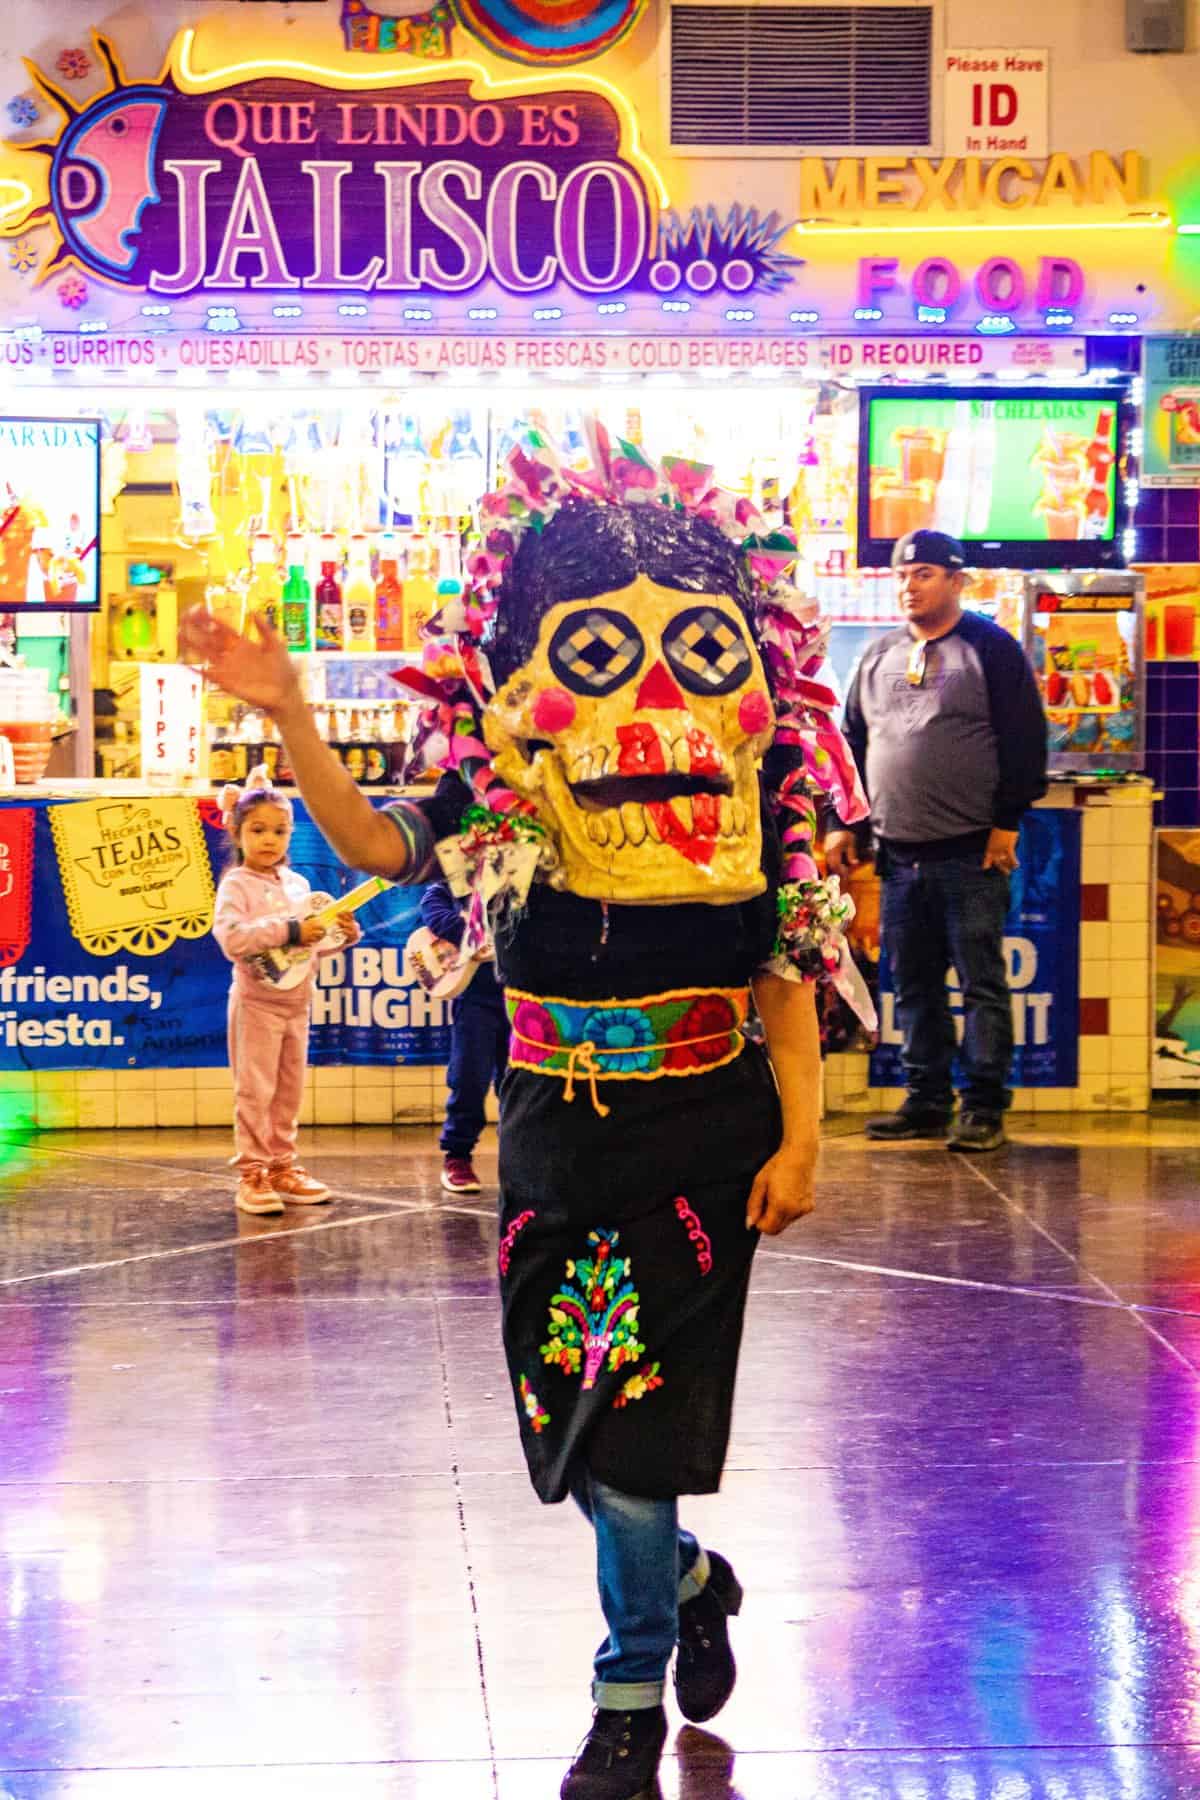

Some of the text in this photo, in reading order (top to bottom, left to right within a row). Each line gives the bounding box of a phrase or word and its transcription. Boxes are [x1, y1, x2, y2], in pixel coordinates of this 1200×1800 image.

[946, 56, 1044, 72] Please Have
[973, 83, 1018, 127] ID
[204, 98, 580, 157] QUE LINDO ES
[966, 135, 1027, 150] In Hand
[800, 150, 1146, 212] MEXICAN
[857, 256, 1086, 312] FOOD
[0, 340, 809, 367] OS BURRITOS QUESADILLAS TORTAS AGUAS FRESCAS COLD BEVERAGES
[830, 343, 983, 365] ID REQUIRED
[156, 677, 166, 758] TIPS
[188, 683, 197, 764] TPS
[91, 826, 182, 869] TEJAS
[0, 966, 162, 1010] friends,
[346, 988, 453, 1029] LIGH
[0, 1011, 125, 1047] iesta.
